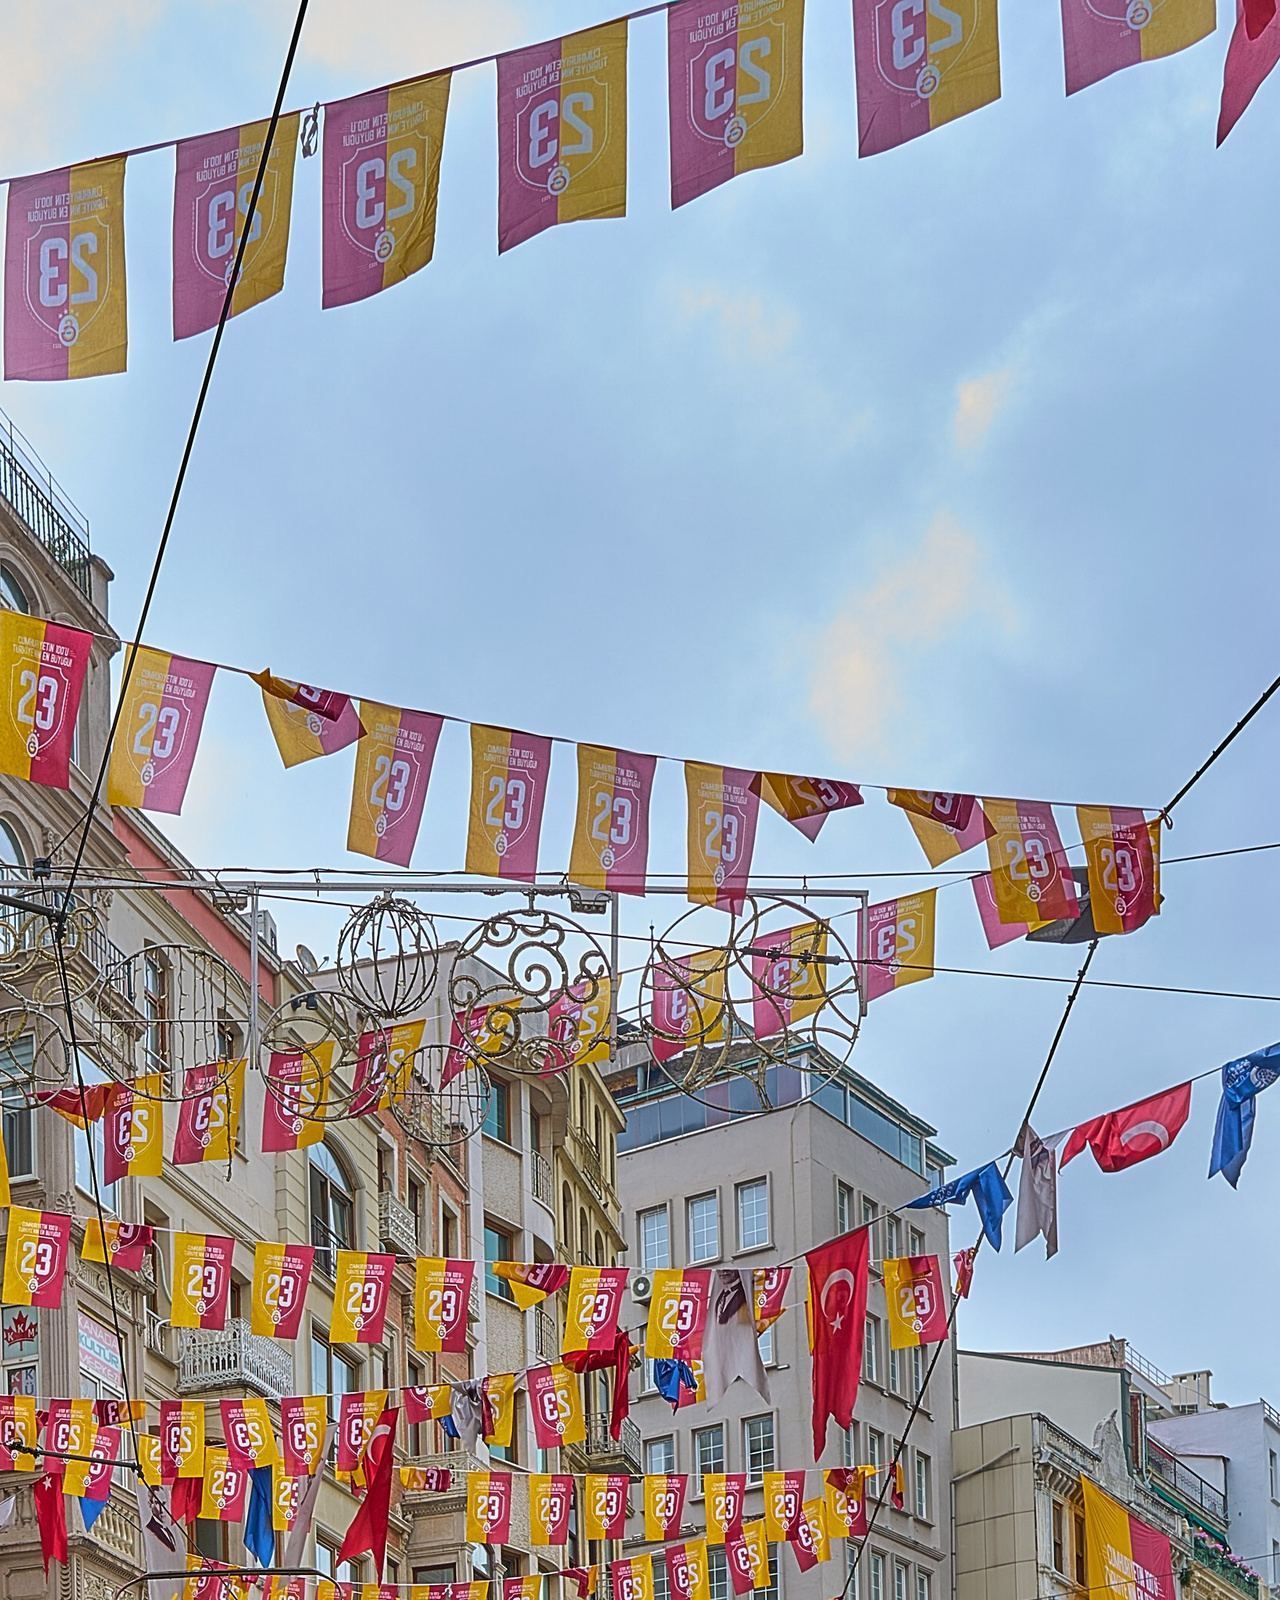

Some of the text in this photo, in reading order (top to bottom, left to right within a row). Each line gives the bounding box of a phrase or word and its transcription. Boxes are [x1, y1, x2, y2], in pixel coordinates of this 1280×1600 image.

[18, 670, 58, 730] 23
[133, 703, 179, 758] 23
[370, 755, 410, 811] 23
[486, 776, 525, 829] 23
[592, 792, 631, 844] 23
[705, 811, 738, 861] 23
[1101, 848, 1135, 891] 23
[21, 1242, 52, 1275] 23
[187, 1265, 216, 1297] 23
[347, 1283, 376, 1312] 23
[429, 1290, 456, 1321] 23
[579, 1294, 608, 1322] 23
[662, 1300, 693, 1330] 23
[77, 1314, 118, 1350] KANADA
[78, 1330, 120, 1367] KÜLTÜR
[212, 1471, 236, 1496] 23
[477, 1496, 499, 1519] 23
[541, 1498, 560, 1521] 23
[596, 1492, 617, 1515] 23
[716, 1496, 734, 1520] 23
